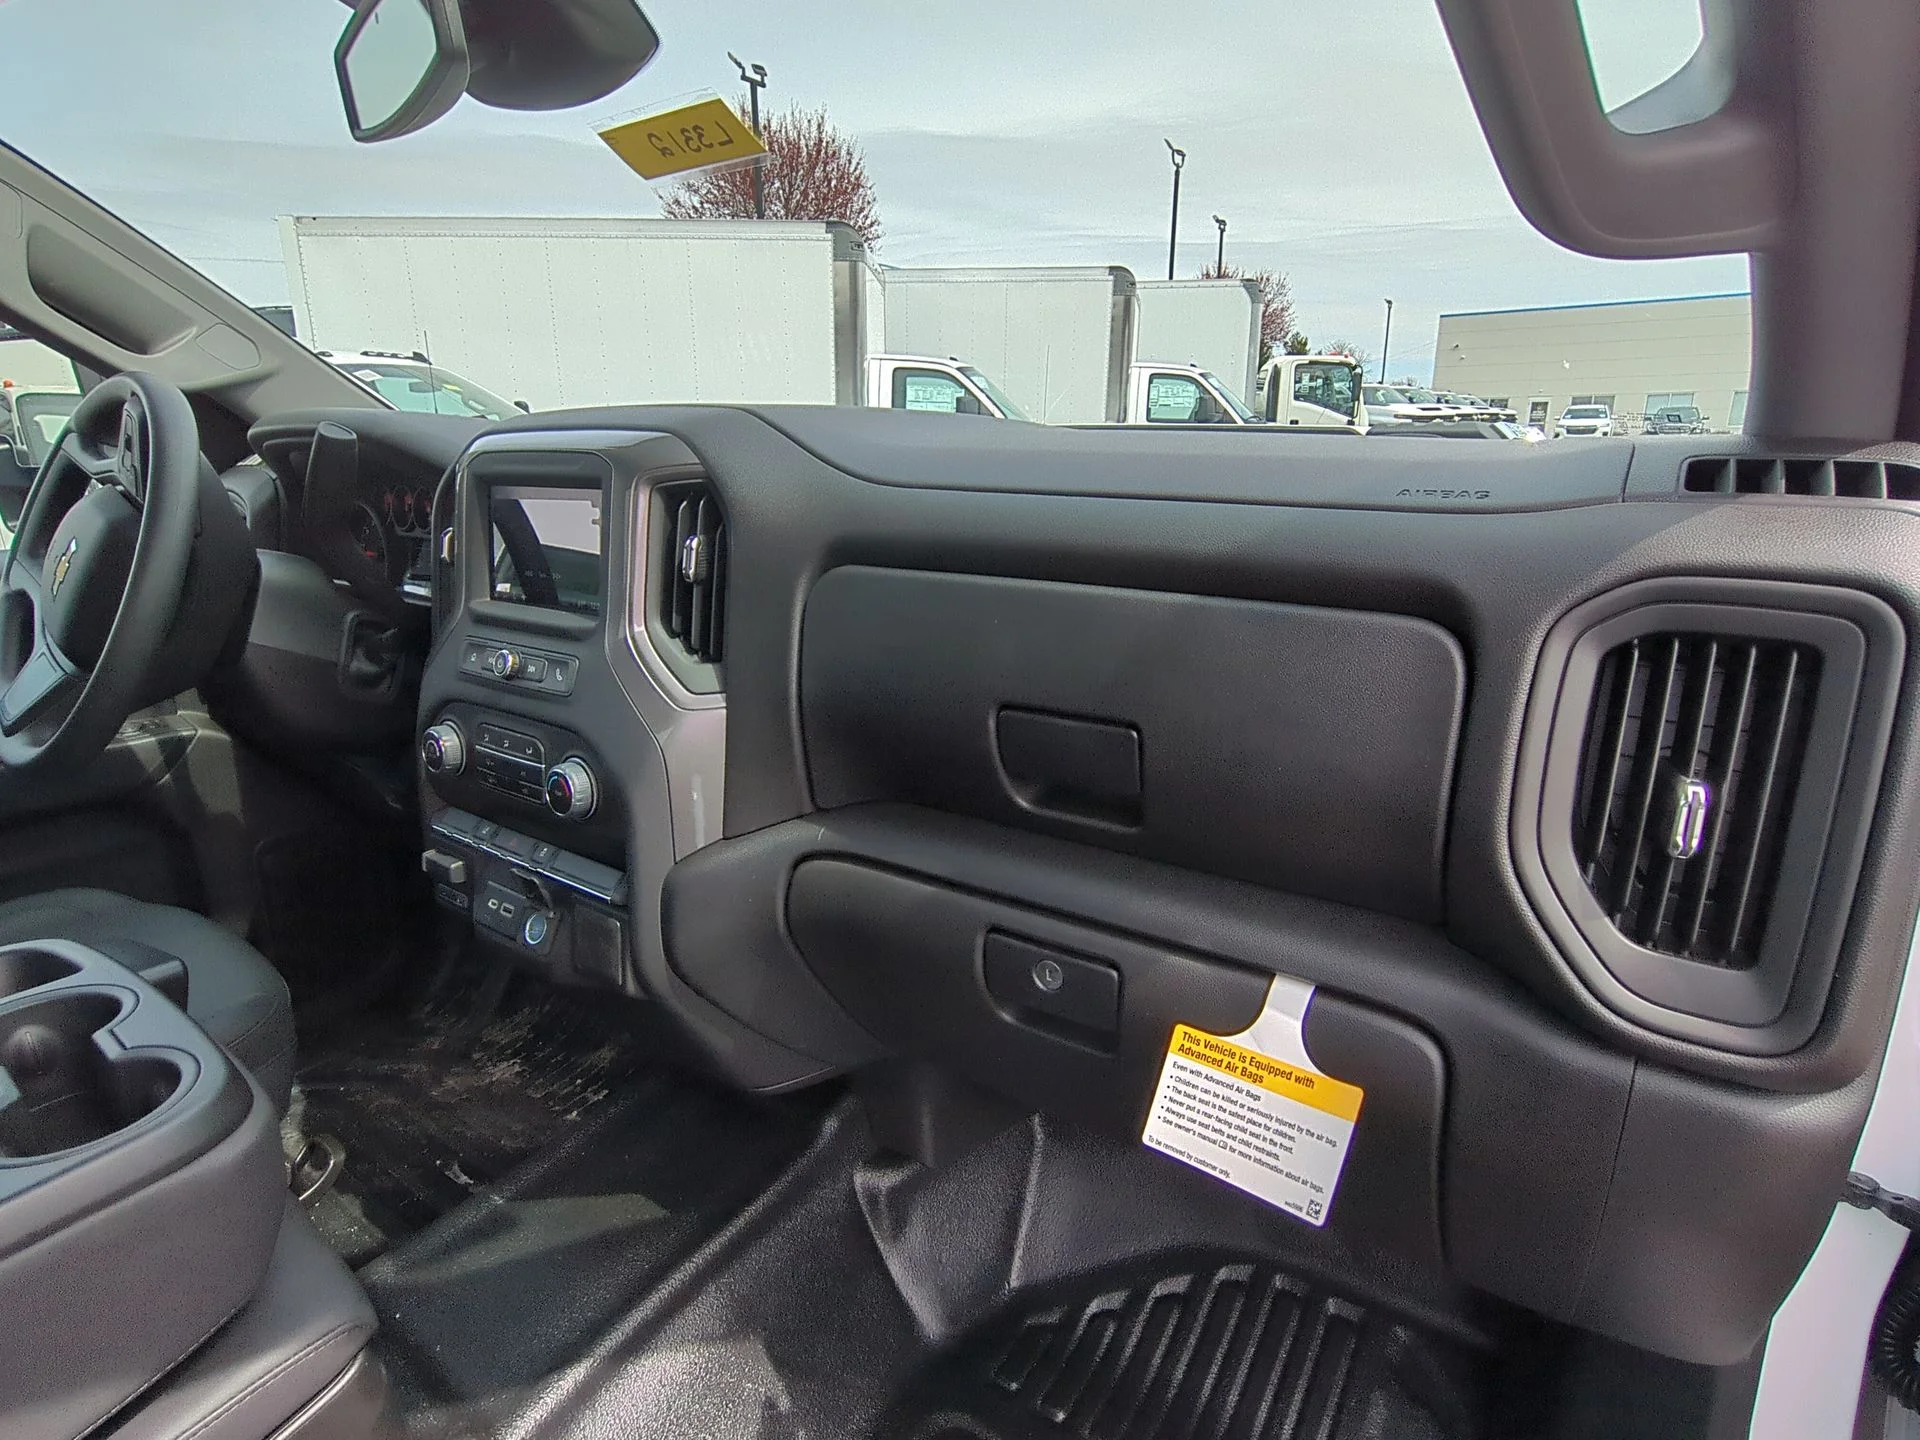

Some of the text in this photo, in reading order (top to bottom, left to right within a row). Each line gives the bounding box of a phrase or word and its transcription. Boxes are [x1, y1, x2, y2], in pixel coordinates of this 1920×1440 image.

[1396, 488, 1491, 499] AIRBAG
[1173, 1061, 1261, 1101] Even with Advanced Air Bags
[1178, 1044, 1264, 1083] Advanced Air Bags
[1182, 1031, 1314, 1089] This Vehicle is Equipped with
[1165, 1107, 1280, 1161] Always use seat belts and child restraints.
[1169, 1096, 1185, 1107] Never
[1186, 1104, 1196, 1112] put
[1201, 1111, 1233, 1129] rear-facing
[1234, 1124, 1248, 1134] child
[1249, 1131, 1261, 1140] seat
[1269, 1138, 1278, 1147] the
[1279, 1143, 1293, 1154] front.
[1172, 1086, 1182, 1095] The
[1183, 1091, 1196, 1101] back
[1198, 1098, 1210, 1107] seat
[1218, 1105, 1227, 1113] the
[1228, 1110, 1246, 1121] safest
[1246, 1118, 1262, 1128] place
[1263, 1124, 1272, 1132] for
[1272, 1129, 1296, 1143] children.
[1175, 1076, 1199, 1090] Children
[1200, 1087, 1211, 1095] can
[1212, 1091, 1220, 1099] be
[1221, 1094, 1238, 1106] killed
[1247, 1106, 1274, 1122] seriously
[1275, 1116, 1296, 1130] injured
[1297, 1125, 1304, 1134] by
[1305, 1129, 1315, 1137] the
[1325, 1136, 1337, 1147] bag.
[1149, 1135, 1154, 1143] To
[1163, 1143, 1186, 1157] removed
[1186, 1152, 1193, 1161] by
[1194, 1157, 1218, 1171] customer
[1218, 1168, 1230, 1178] only.
[1162, 1117, 1173, 1126] See
[1174, 1123, 1196, 1136] owner's
[1197, 1132, 1218, 1145] manual
[1229, 1145, 1237, 1153] for
[1238, 1150, 1252, 1161] more
[1253, 1156, 1284, 1175] information
[1285, 1172, 1300, 1183] about
[1309, 1181, 1324, 1194] bags.
